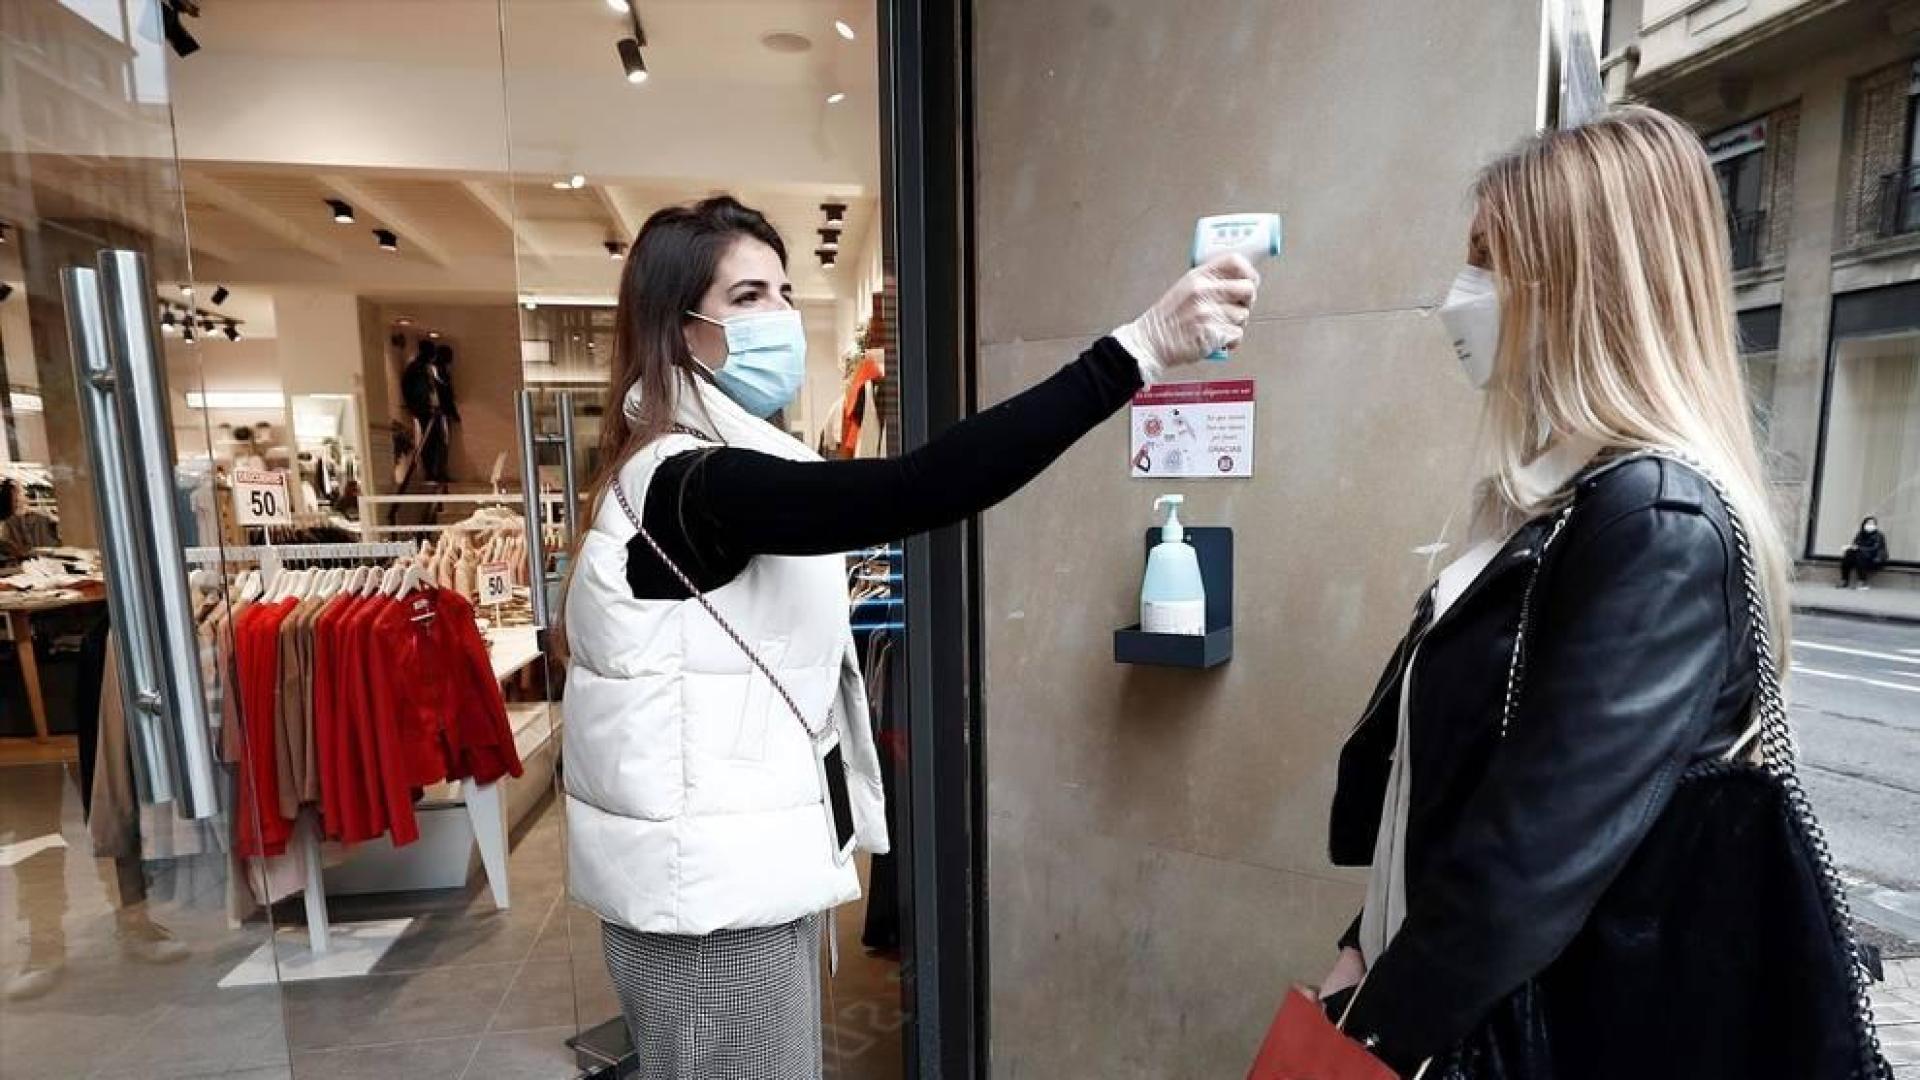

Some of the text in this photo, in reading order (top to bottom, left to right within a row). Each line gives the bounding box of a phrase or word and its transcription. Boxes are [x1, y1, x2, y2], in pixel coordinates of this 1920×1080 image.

[1208, 445, 1242, 453] GRACIAS
[251, 490, 276, 516] 50
[488, 576, 503, 595] 50
